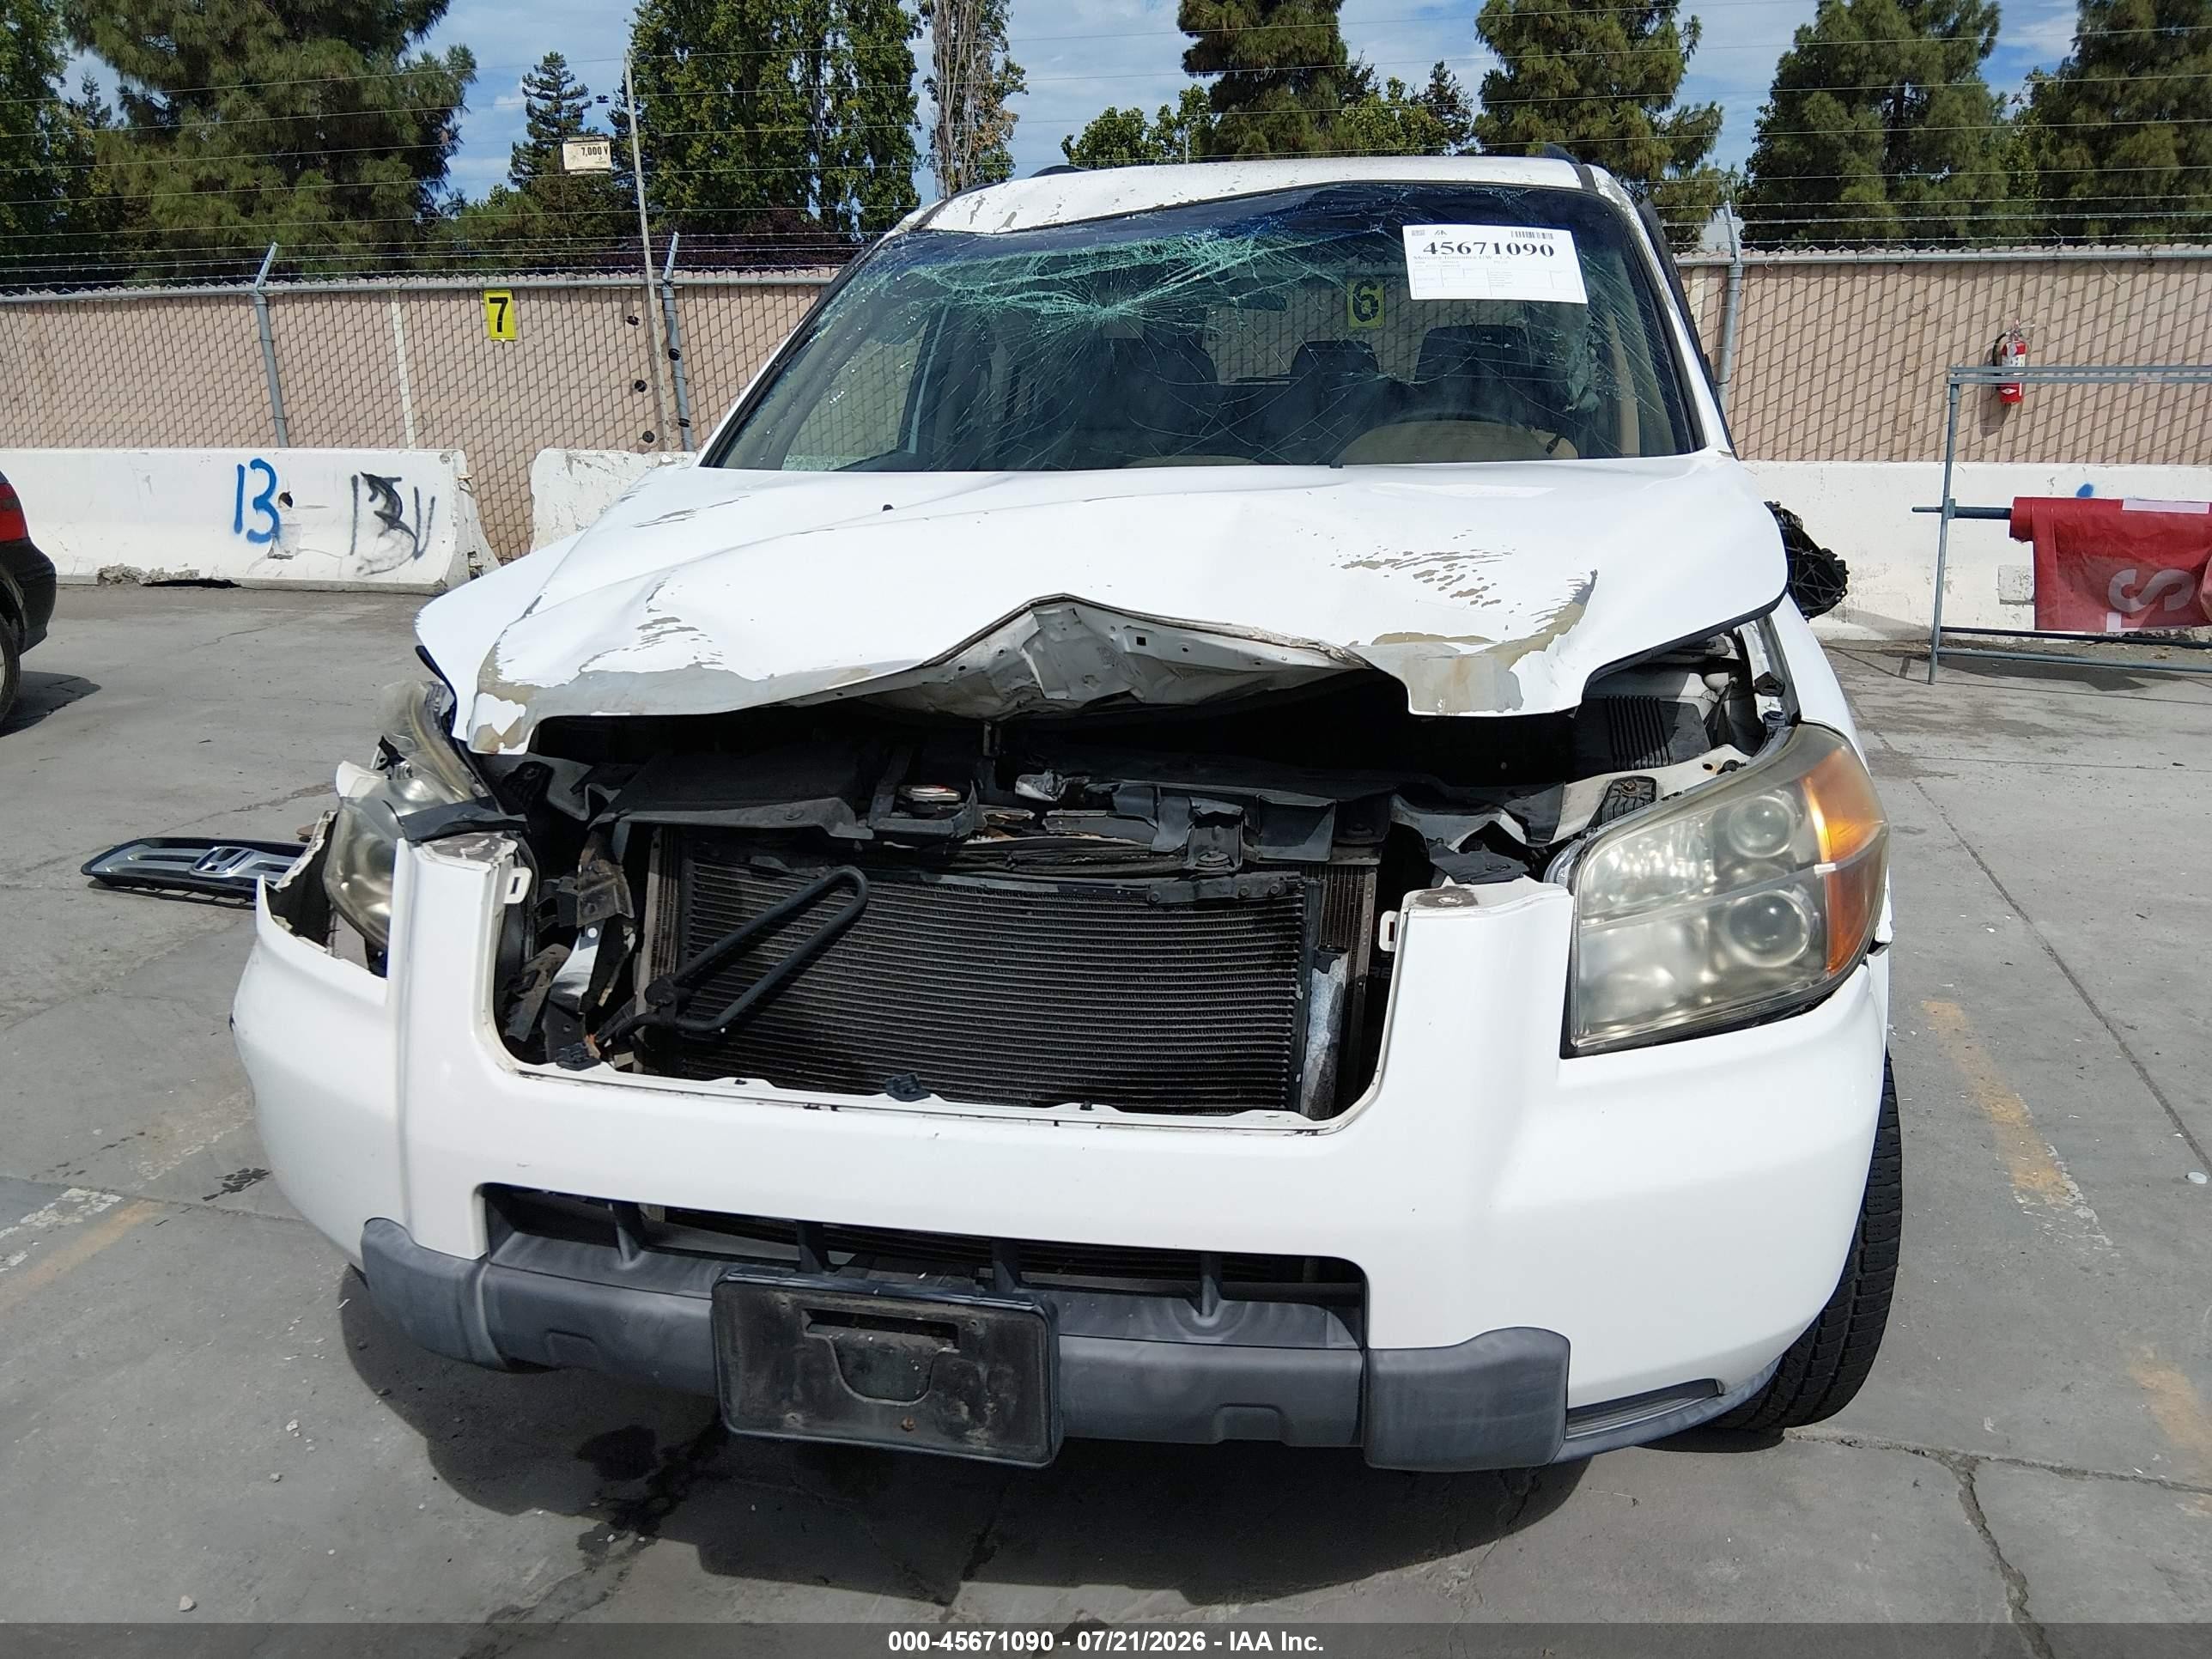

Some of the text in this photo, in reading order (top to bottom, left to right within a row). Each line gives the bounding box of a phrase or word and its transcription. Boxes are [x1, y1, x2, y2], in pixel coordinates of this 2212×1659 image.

[580, 145, 609, 157] 7,000 V
[1423, 240, 1554, 257] 45671090
[488, 296, 508, 333] 7
[1352, 280, 1379, 322] 6
